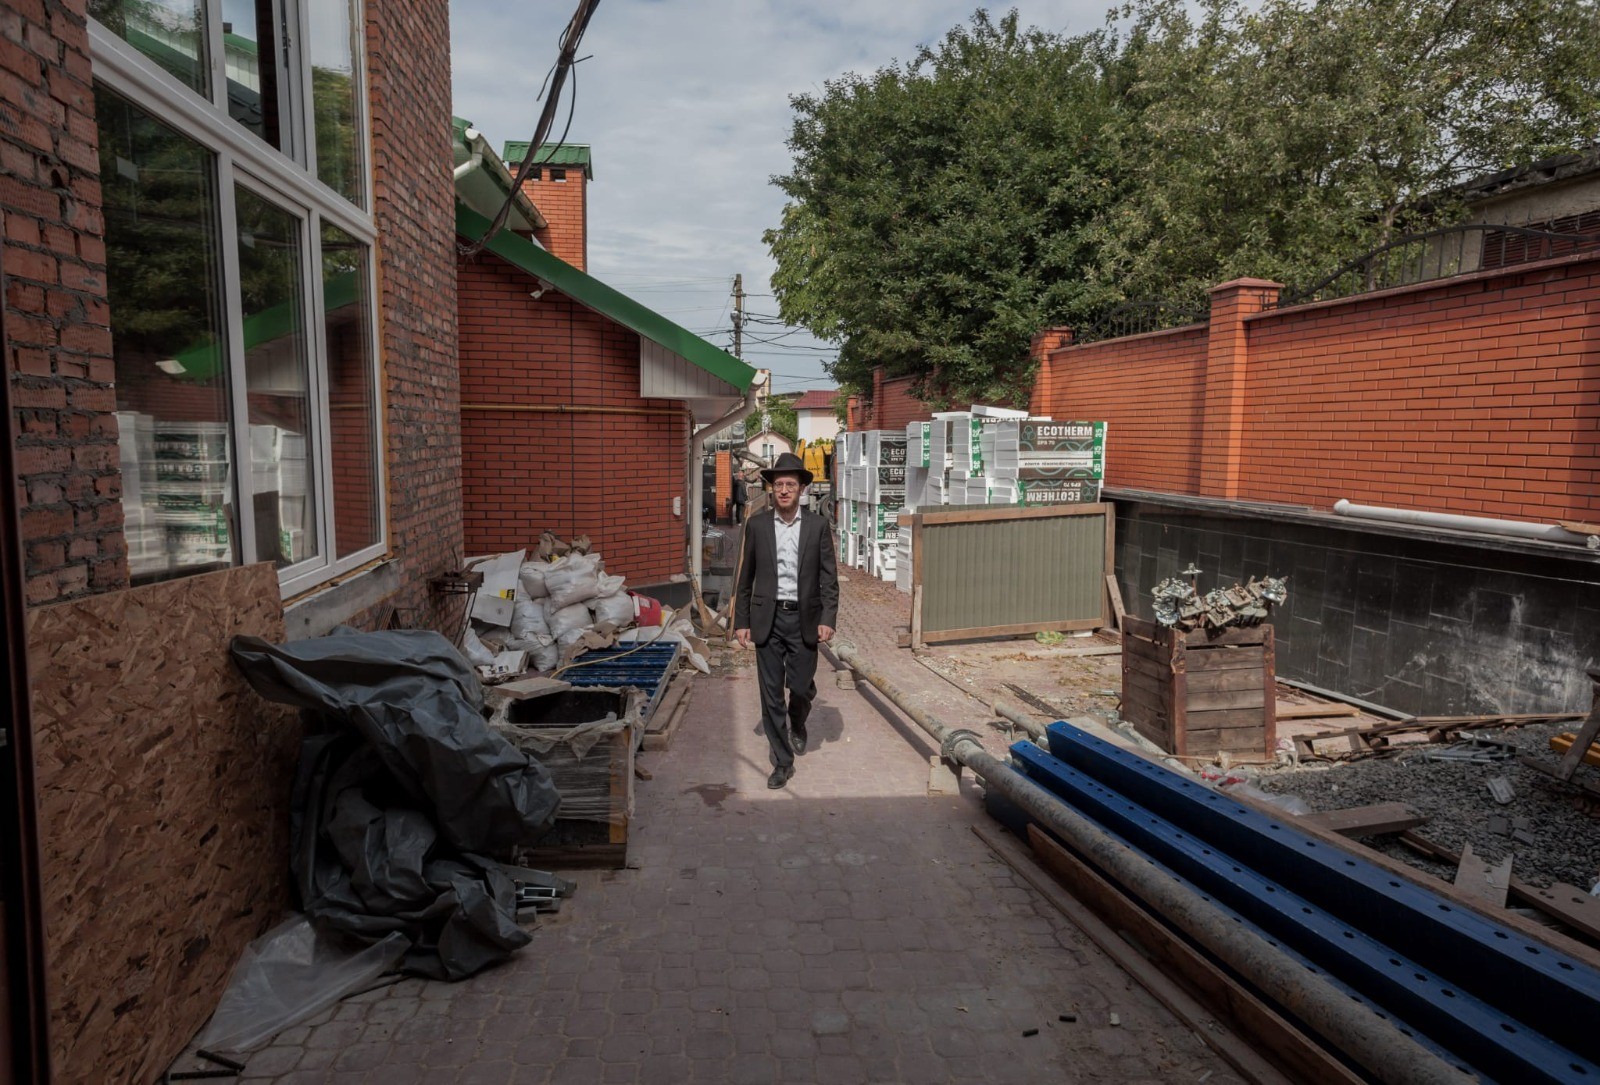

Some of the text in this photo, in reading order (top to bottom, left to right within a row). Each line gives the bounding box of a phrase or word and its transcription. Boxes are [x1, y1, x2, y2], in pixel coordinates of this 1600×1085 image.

[1037, 426, 1093, 436] ECOTHERM
[923, 453, 930, 461] 35
[973, 460, 980, 469] 35
[1026, 492, 1081, 502] ECOTHERM
